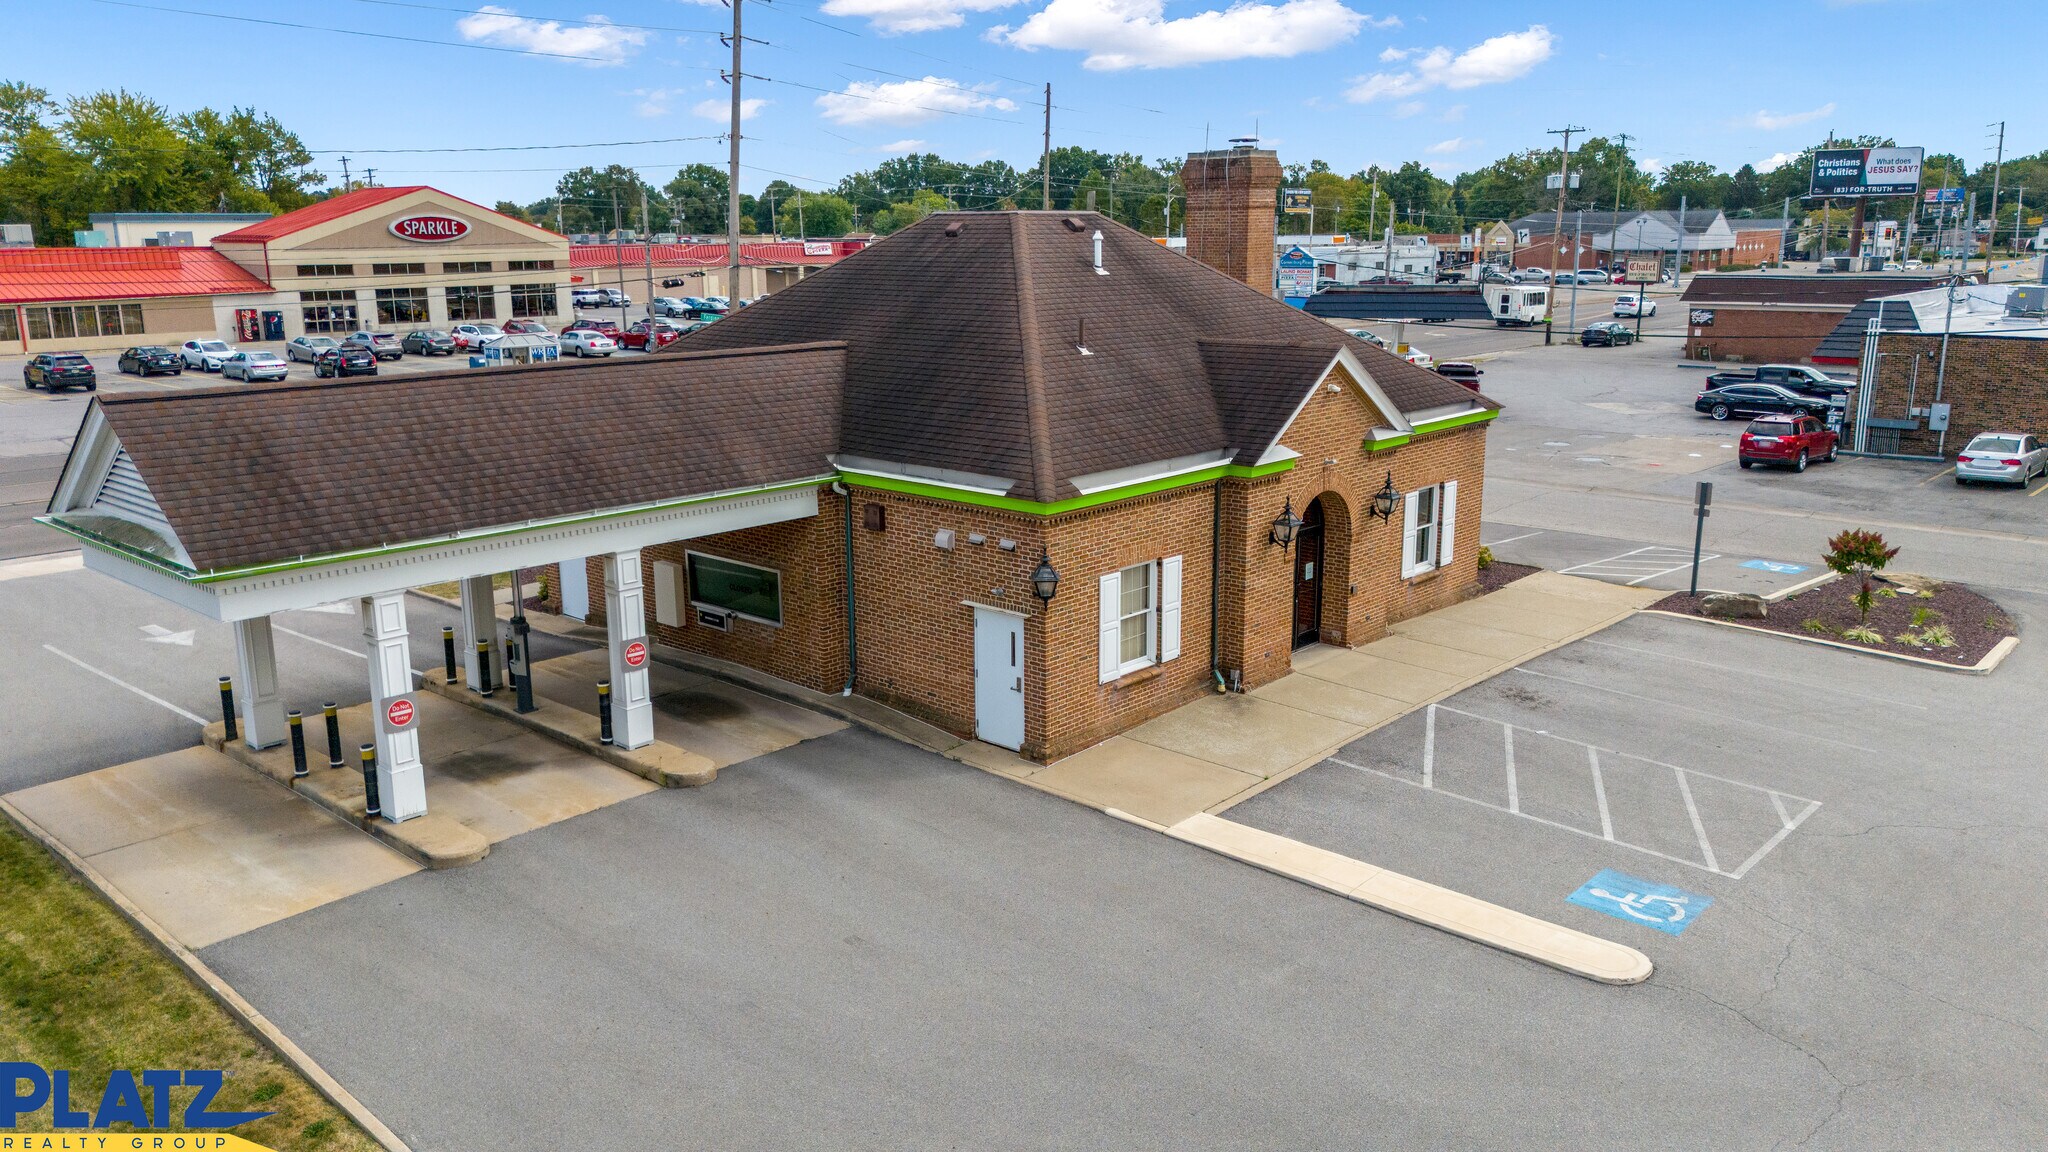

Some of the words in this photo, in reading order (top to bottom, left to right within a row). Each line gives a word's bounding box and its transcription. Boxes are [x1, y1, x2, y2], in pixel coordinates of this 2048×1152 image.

[1818, 159, 1861, 167] Christians
[1818, 169, 1825, 177] &
[1826, 168, 1858, 176] Politics
[1867, 166, 1895, 174] JESUS
[1896, 165, 1919, 173] SAY?
[1833, 186, 1848, 194] (83)
[403, 220, 459, 235] SPARKLE
[1630, 262, 1656, 271] Chalet
